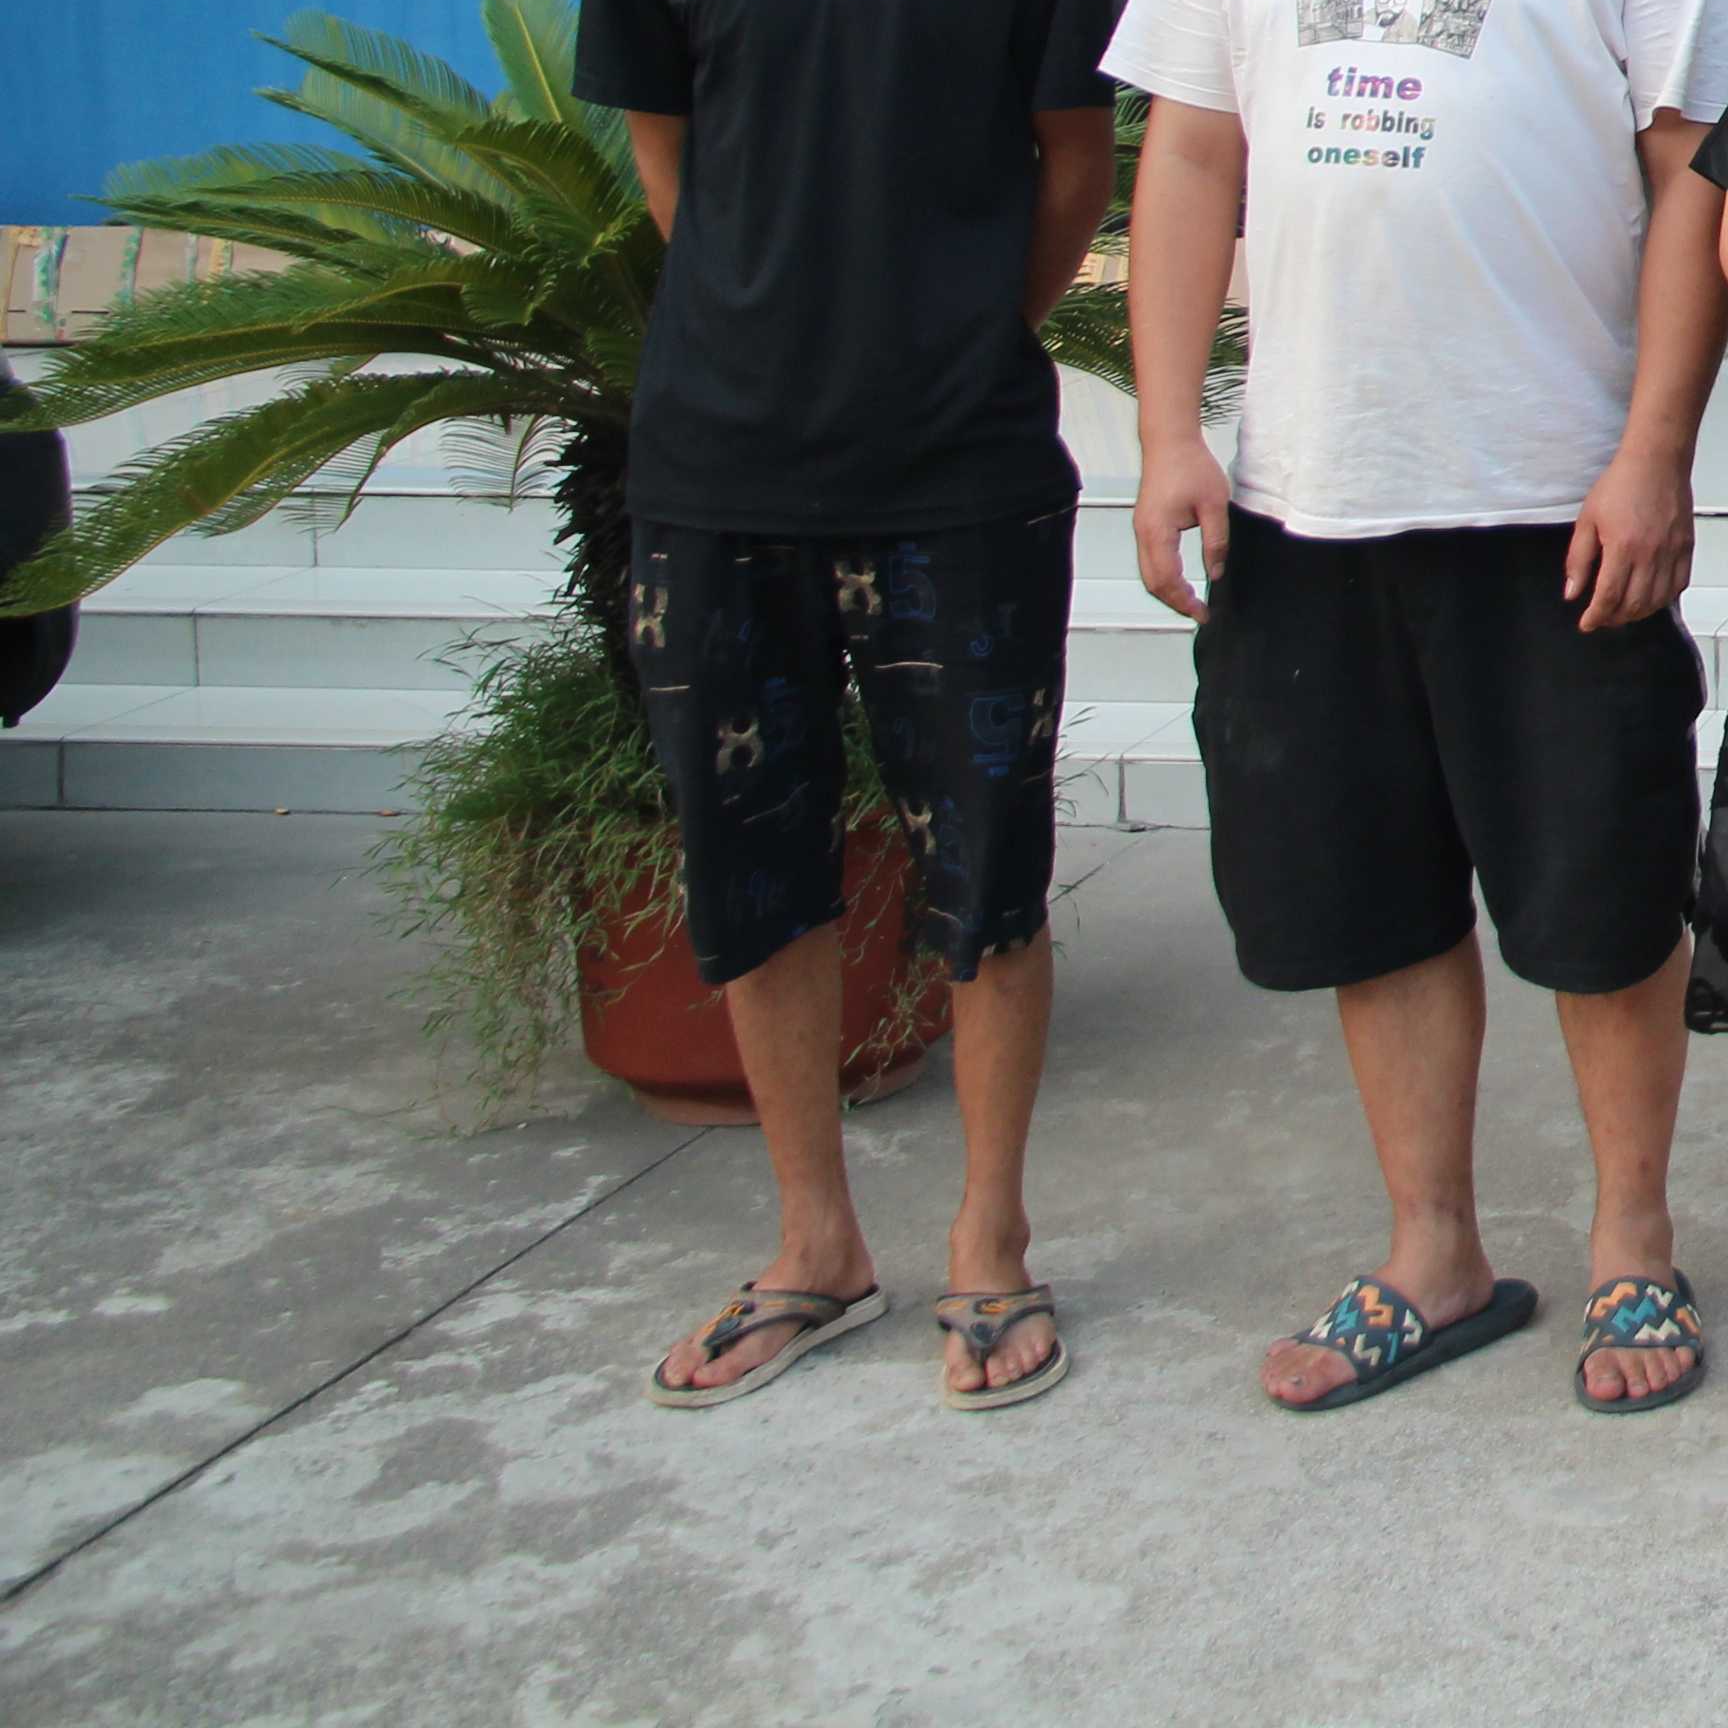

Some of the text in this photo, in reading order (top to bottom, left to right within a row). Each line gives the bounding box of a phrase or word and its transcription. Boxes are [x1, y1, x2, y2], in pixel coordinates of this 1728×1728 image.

[1327, 66, 1423, 101] time
[1306, 106, 1437, 141] is robbing
[1307, 146, 1426, 169] oneself
